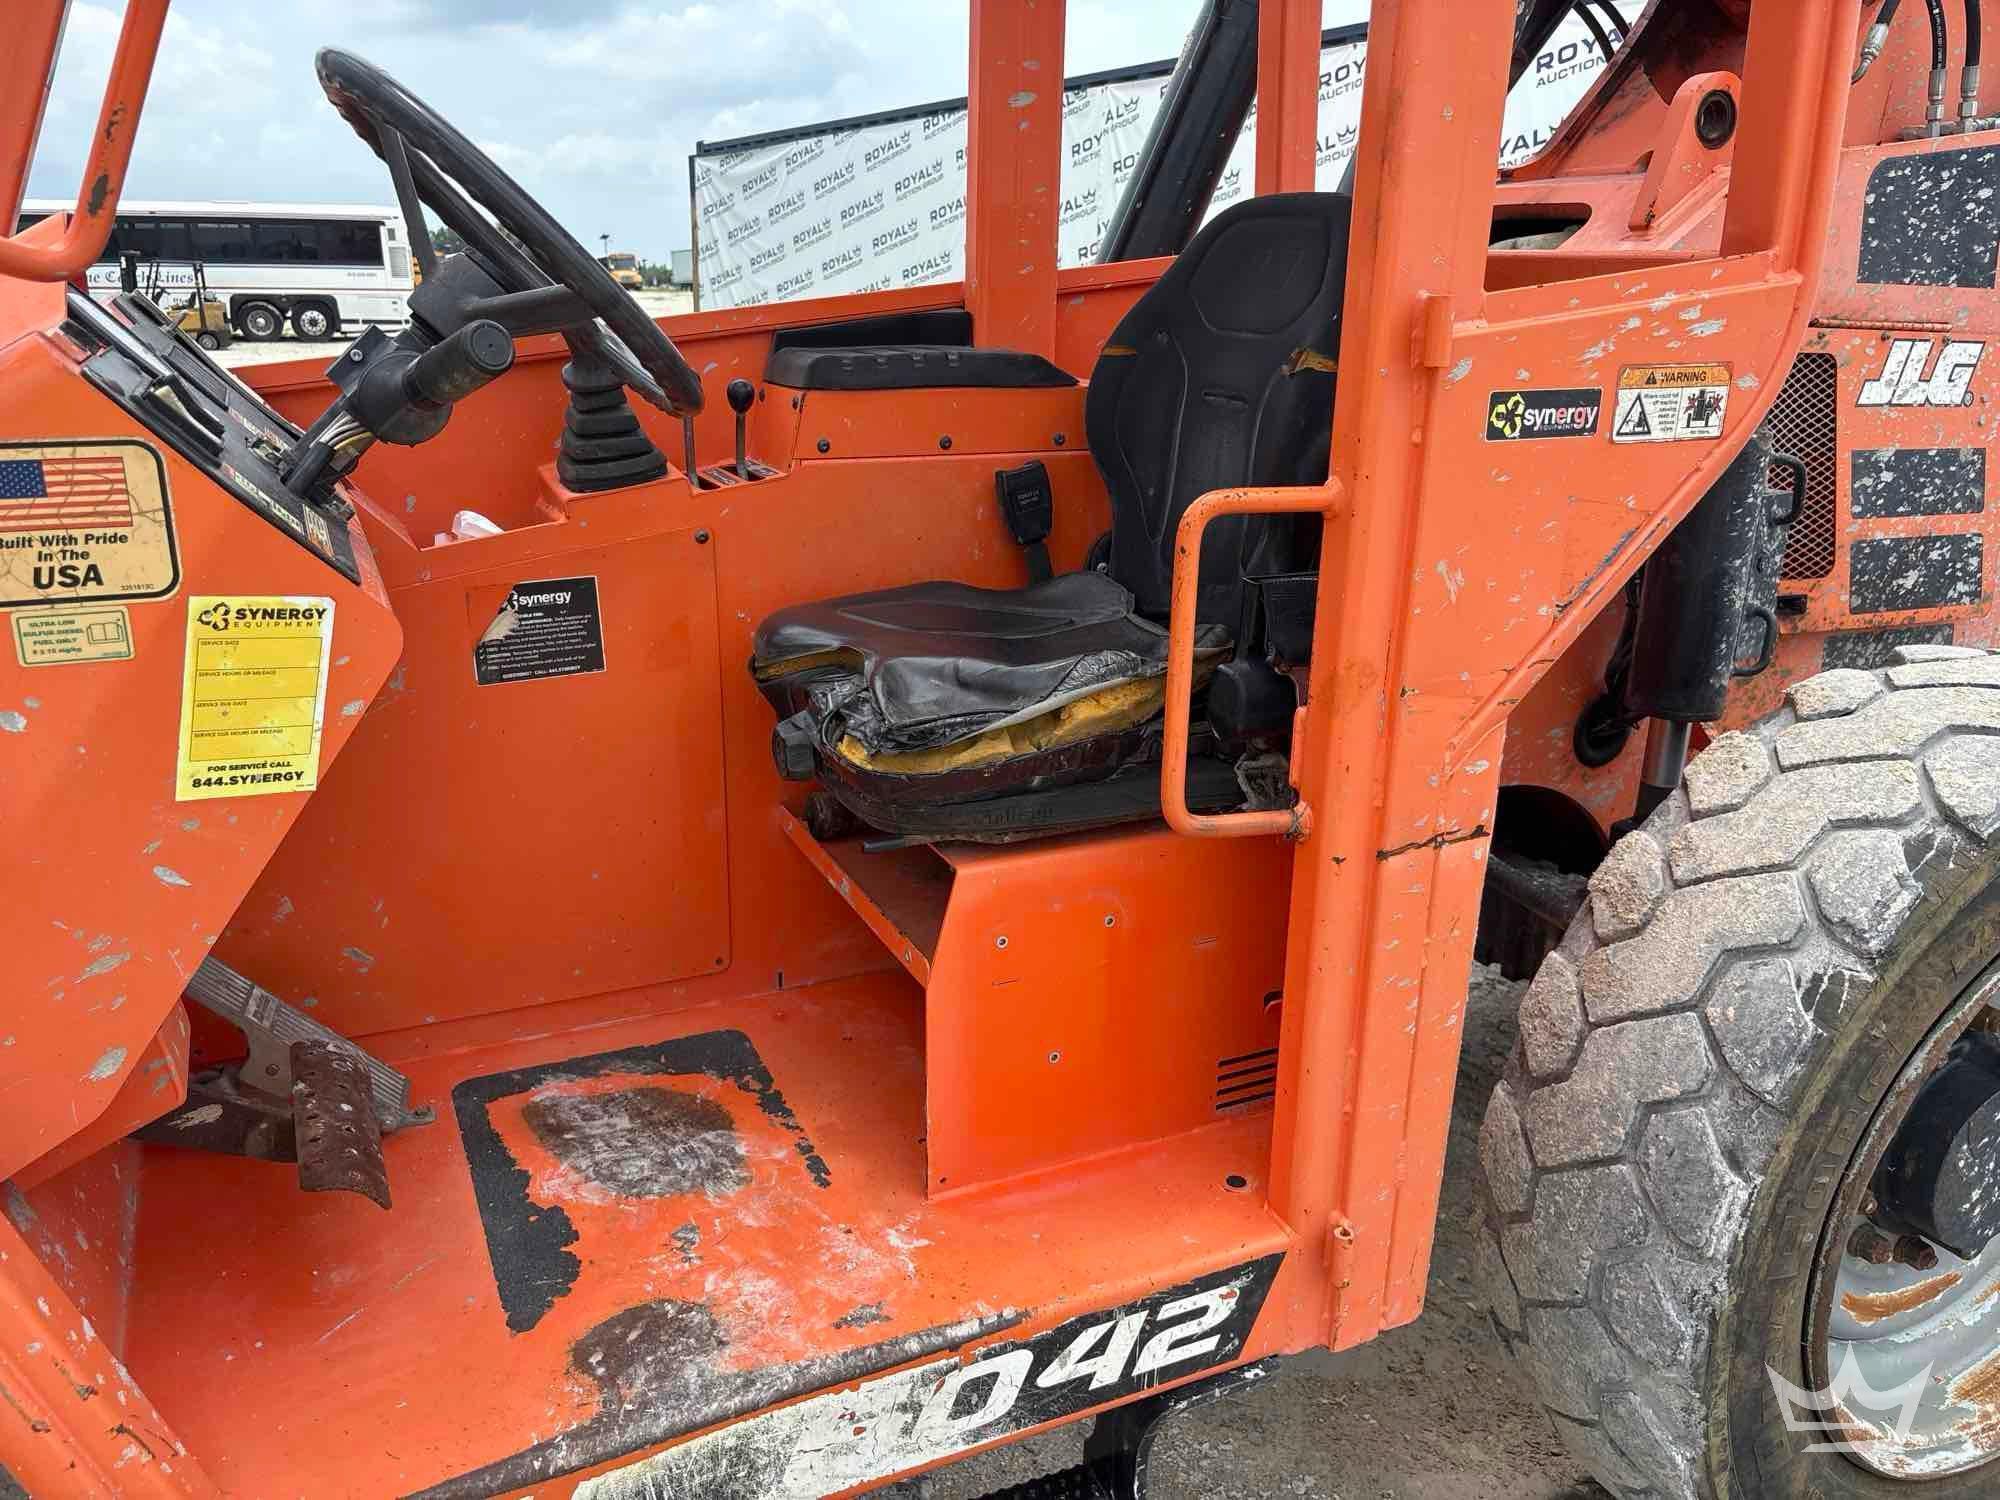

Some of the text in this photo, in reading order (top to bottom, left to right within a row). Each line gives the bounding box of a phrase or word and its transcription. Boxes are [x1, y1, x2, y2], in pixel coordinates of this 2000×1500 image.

[1536, 28, 1623, 73] ROYA
[1319, 57, 1365, 89] ROY
[1319, 78, 1362, 102] AUCTIO
[864, 138, 901, 164] ROYAL
[1499, 129, 1548, 158] YAL
[785, 144, 815, 168] ROYAL
[742, 168, 769, 193] ROYAL
[814, 168, 846, 192] ROYAL
[895, 166, 932, 194] ROYAL
[1213, 187, 1241, 202] ROUP
[703, 197, 728, 216] ROYAL
[768, 194, 799, 218] ROYAL
[840, 198, 874, 220] ROYAL
[930, 196, 966, 222] ROYA
[728, 219, 757, 240] ROYAL
[792, 226, 821, 246] ROYAL
[872, 225, 908, 250] ROYAL
[750, 248, 779, 267] ROYAL
[822, 250, 854, 272] ROYAL
[902, 256, 940, 280] ROYAL
[710, 269, 735, 286] ROYAL
[776, 274, 806, 292] ROYAL
[1661, 370, 1707, 383] WARNING
[1856, 338, 1985, 407] JLG
[1523, 406, 1598, 431] synergy
[40, 534, 78, 547] With
[84, 533, 128, 545] Pride
[38, 550, 90, 562] In The
[33, 564, 104, 590] USA
[519, 591, 571, 607] synergy
[234, 621, 322, 629] EQUIPMENT
[235, 608, 327, 620] SYNERGY
[229, 762, 268, 771] SERVICE
[192, 771, 304, 788] 844.SYNERGY
